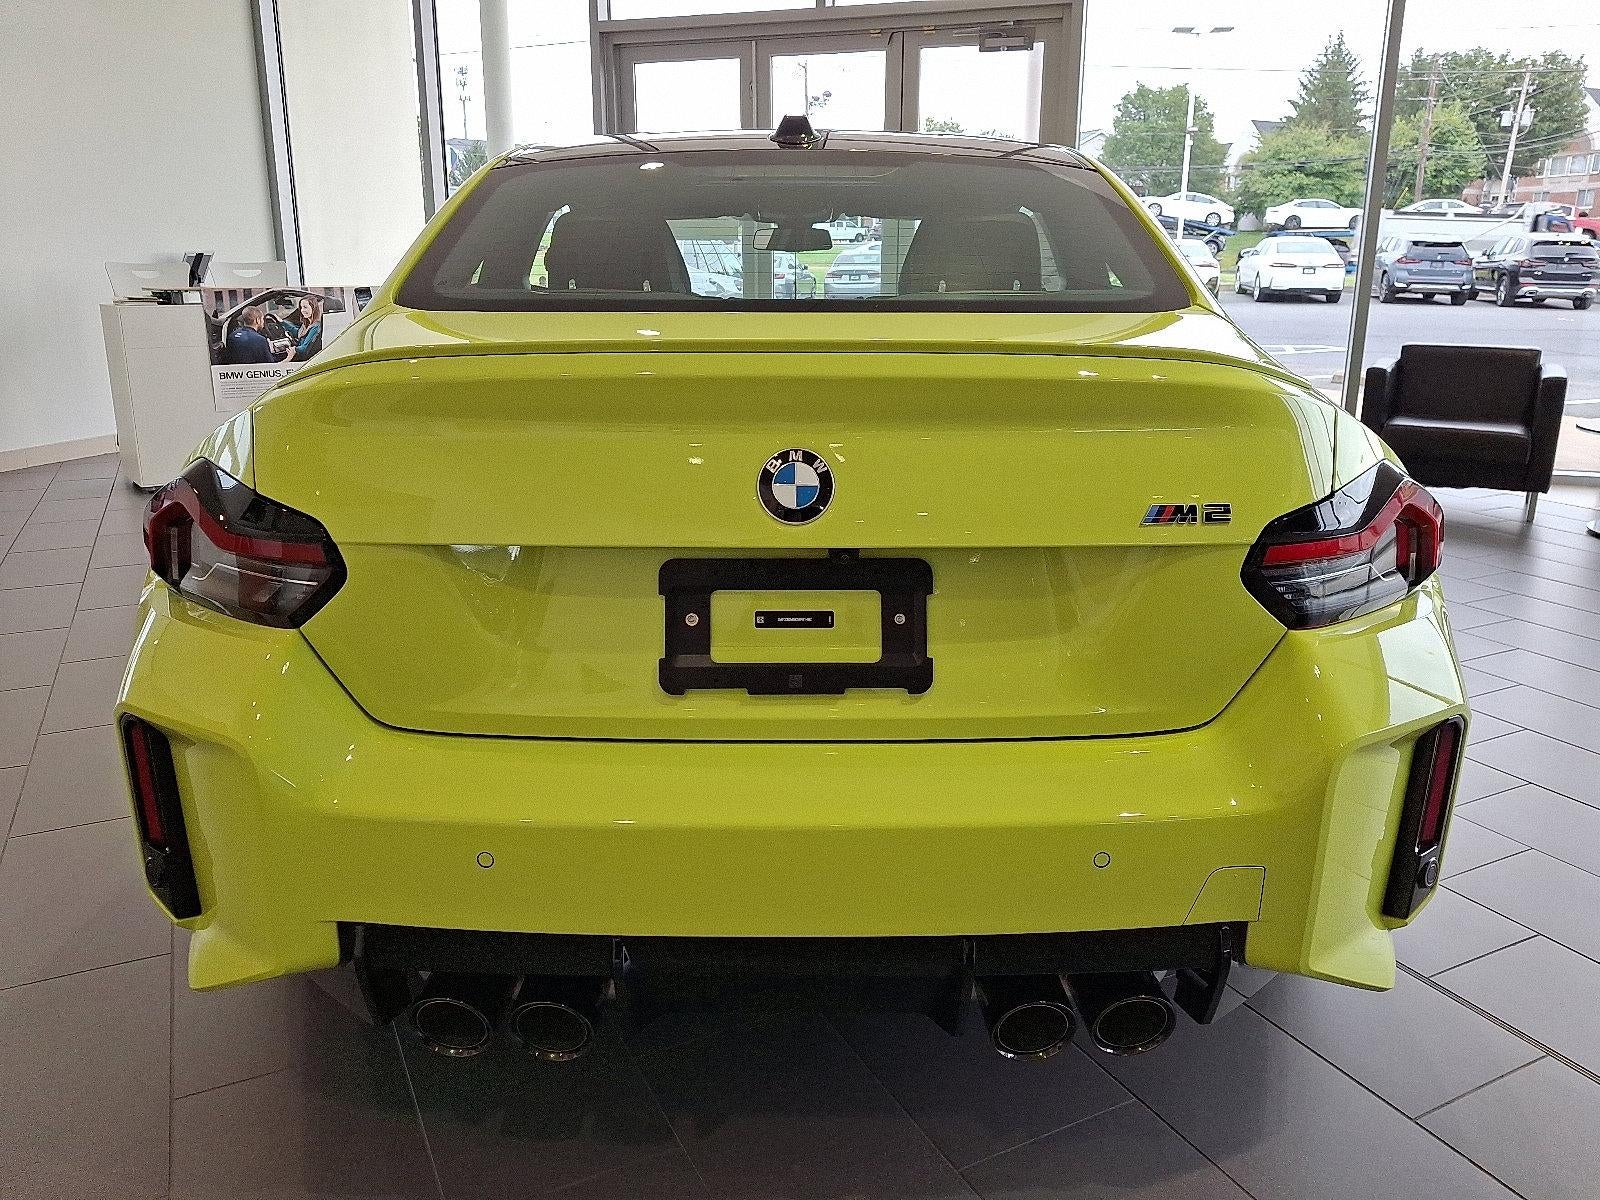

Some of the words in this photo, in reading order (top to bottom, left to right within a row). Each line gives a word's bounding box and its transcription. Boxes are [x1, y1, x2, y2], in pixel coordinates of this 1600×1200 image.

[219, 371, 243, 380] BMW
[766, 450, 827, 473] BMW
[1140, 503, 1232, 524] M2
